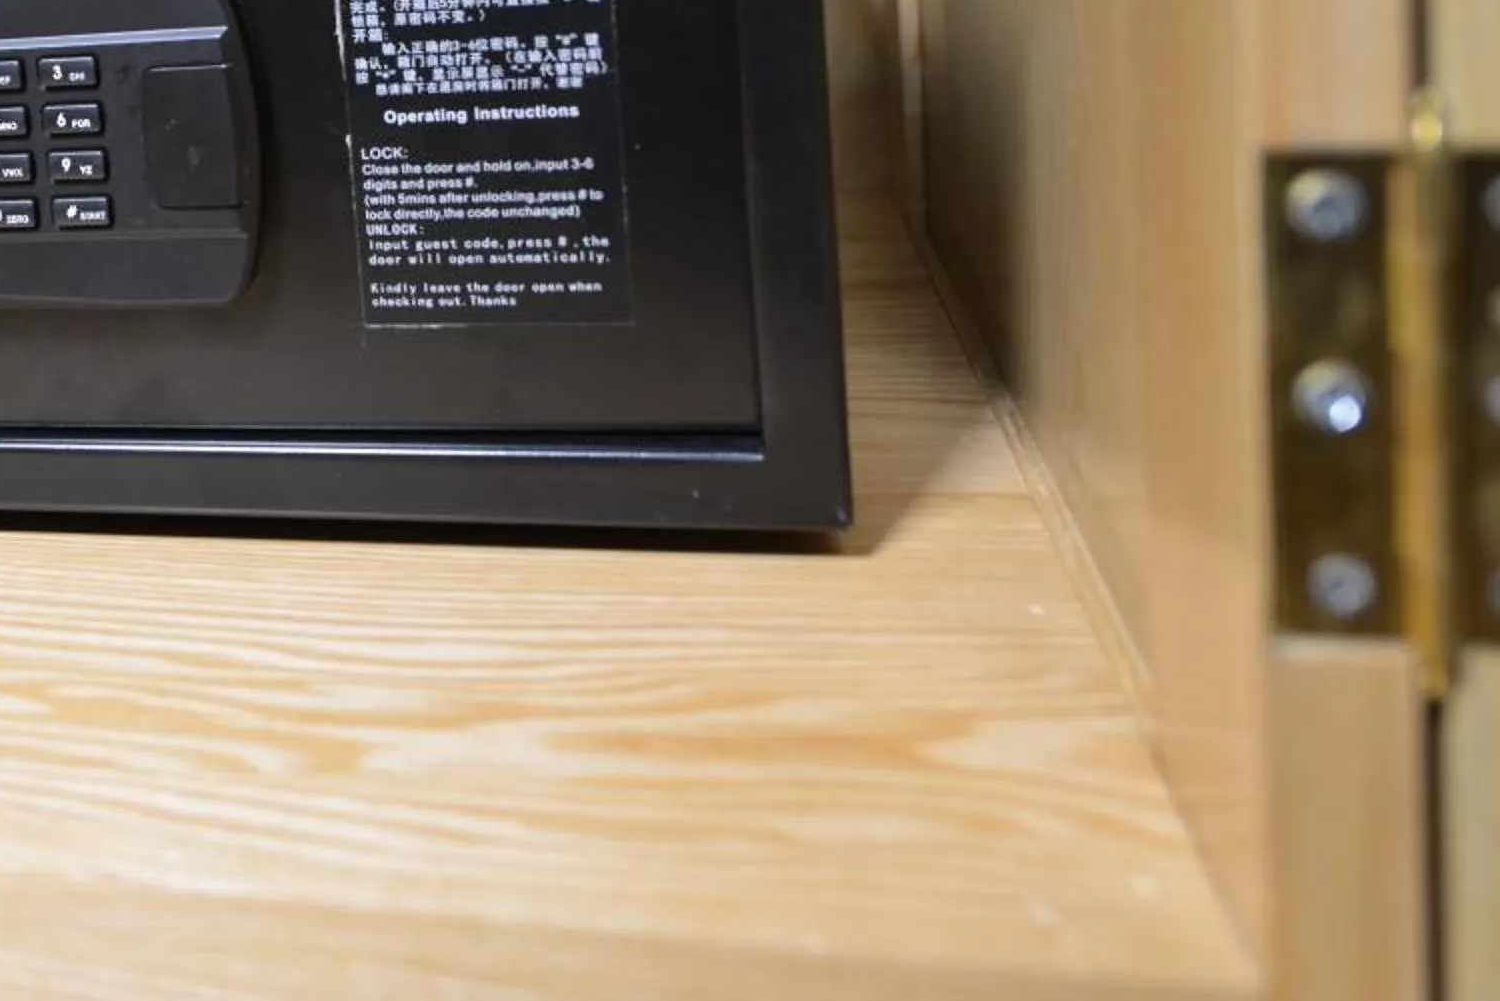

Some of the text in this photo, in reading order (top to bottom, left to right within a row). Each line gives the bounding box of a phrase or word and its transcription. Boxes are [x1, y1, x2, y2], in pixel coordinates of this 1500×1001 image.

[52, 65, 63, 80] 3
[56, 113, 67, 127] 6
[384, 105, 580, 126] Operating Instructions
[361, 148, 409, 160] LOCK:
[61, 158, 71, 173] 9
[362, 163, 400, 175] Close
[401, 163, 422, 174] the
[424, 162, 453, 174] door
[456, 161, 481, 173] and
[484, 160, 512, 172] hold
[363, 179, 397, 193] digits
[401, 178, 424, 190] and
[427, 178, 464, 191] press
[364, 194, 396, 207] (with
[397, 193, 436, 205] 5mins
[438, 192, 470, 204] after
[589, 189, 604, 200] to
[66, 205, 78, 218] #
[365, 208, 392, 220] lock
[467, 207, 499, 218] code
[501, 205, 581, 219] unchanged)
[368, 239, 409, 252] Input
[415, 238, 457, 252] guest
[368, 251, 612, 267] door will open automatically.
[370, 281, 602, 296] Kindly leave the door open when
[371, 295, 434, 308] checking
